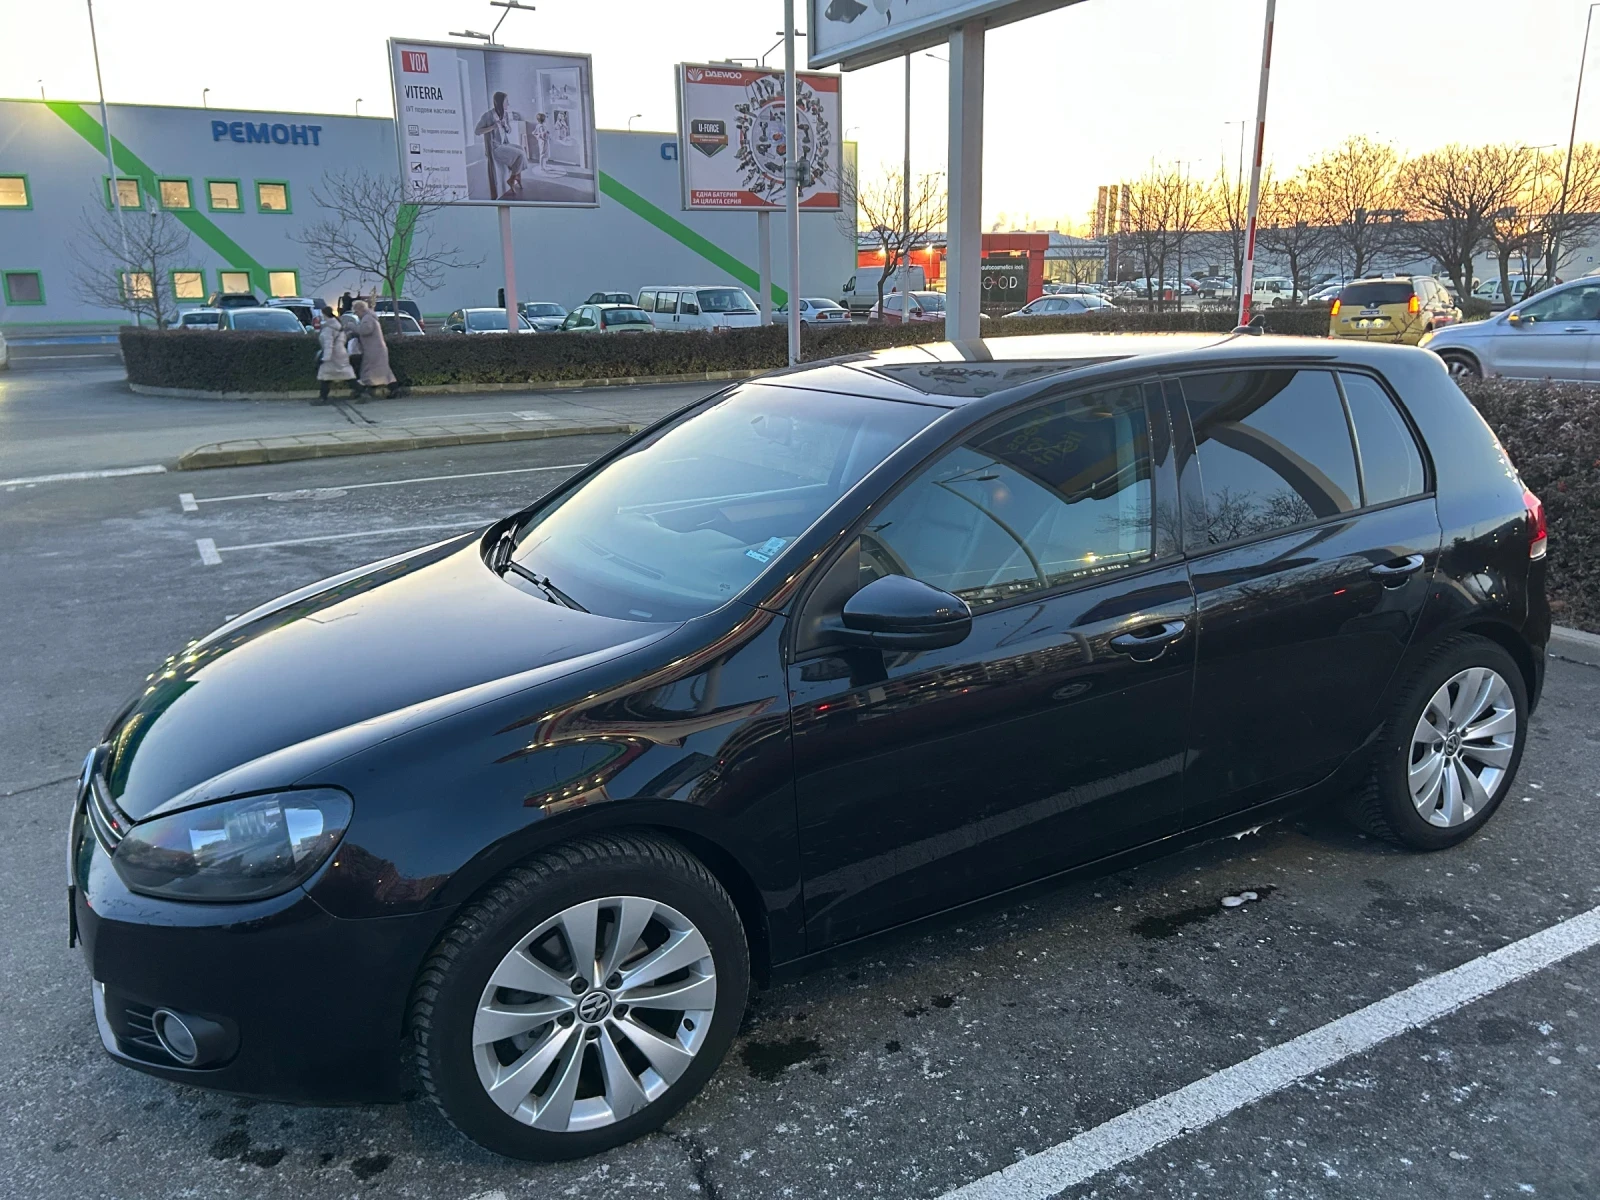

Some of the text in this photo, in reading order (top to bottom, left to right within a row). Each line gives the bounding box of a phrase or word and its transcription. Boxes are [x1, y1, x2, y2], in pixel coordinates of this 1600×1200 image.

[409, 53, 427, 72] VOX
[705, 70, 742, 79] DAEWOO
[404, 85, 443, 101] VITERRA
[211, 120, 322, 146] РЕМОНТ
[698, 123, 720, 133] U-FORCE
